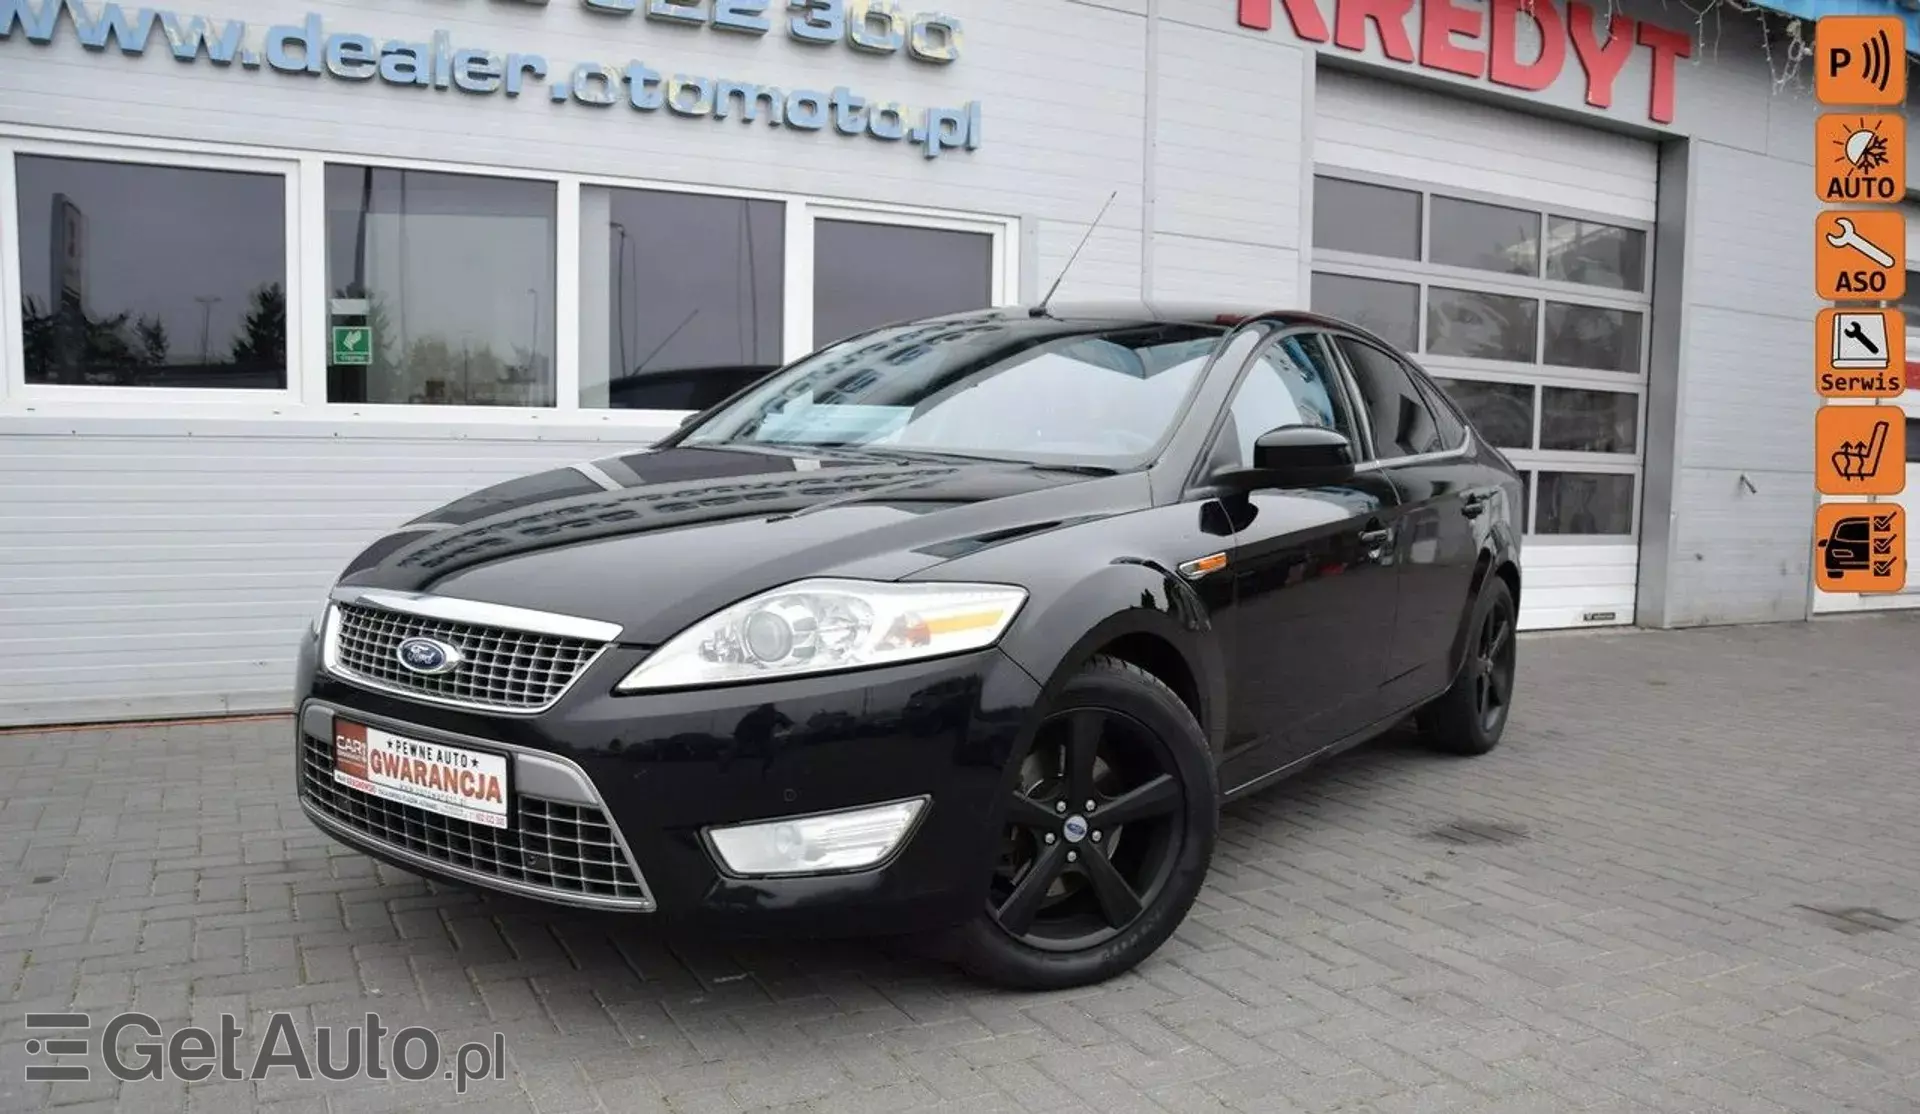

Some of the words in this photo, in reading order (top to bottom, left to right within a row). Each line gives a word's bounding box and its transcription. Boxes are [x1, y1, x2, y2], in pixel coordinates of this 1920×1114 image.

[0, 0, 981, 159] www.dealer.otomoto.pl
[370, 748, 503, 804] GWARANCJA
[396, 740, 432, 760] PEWNE
[436, 751, 468, 768] AUTO
